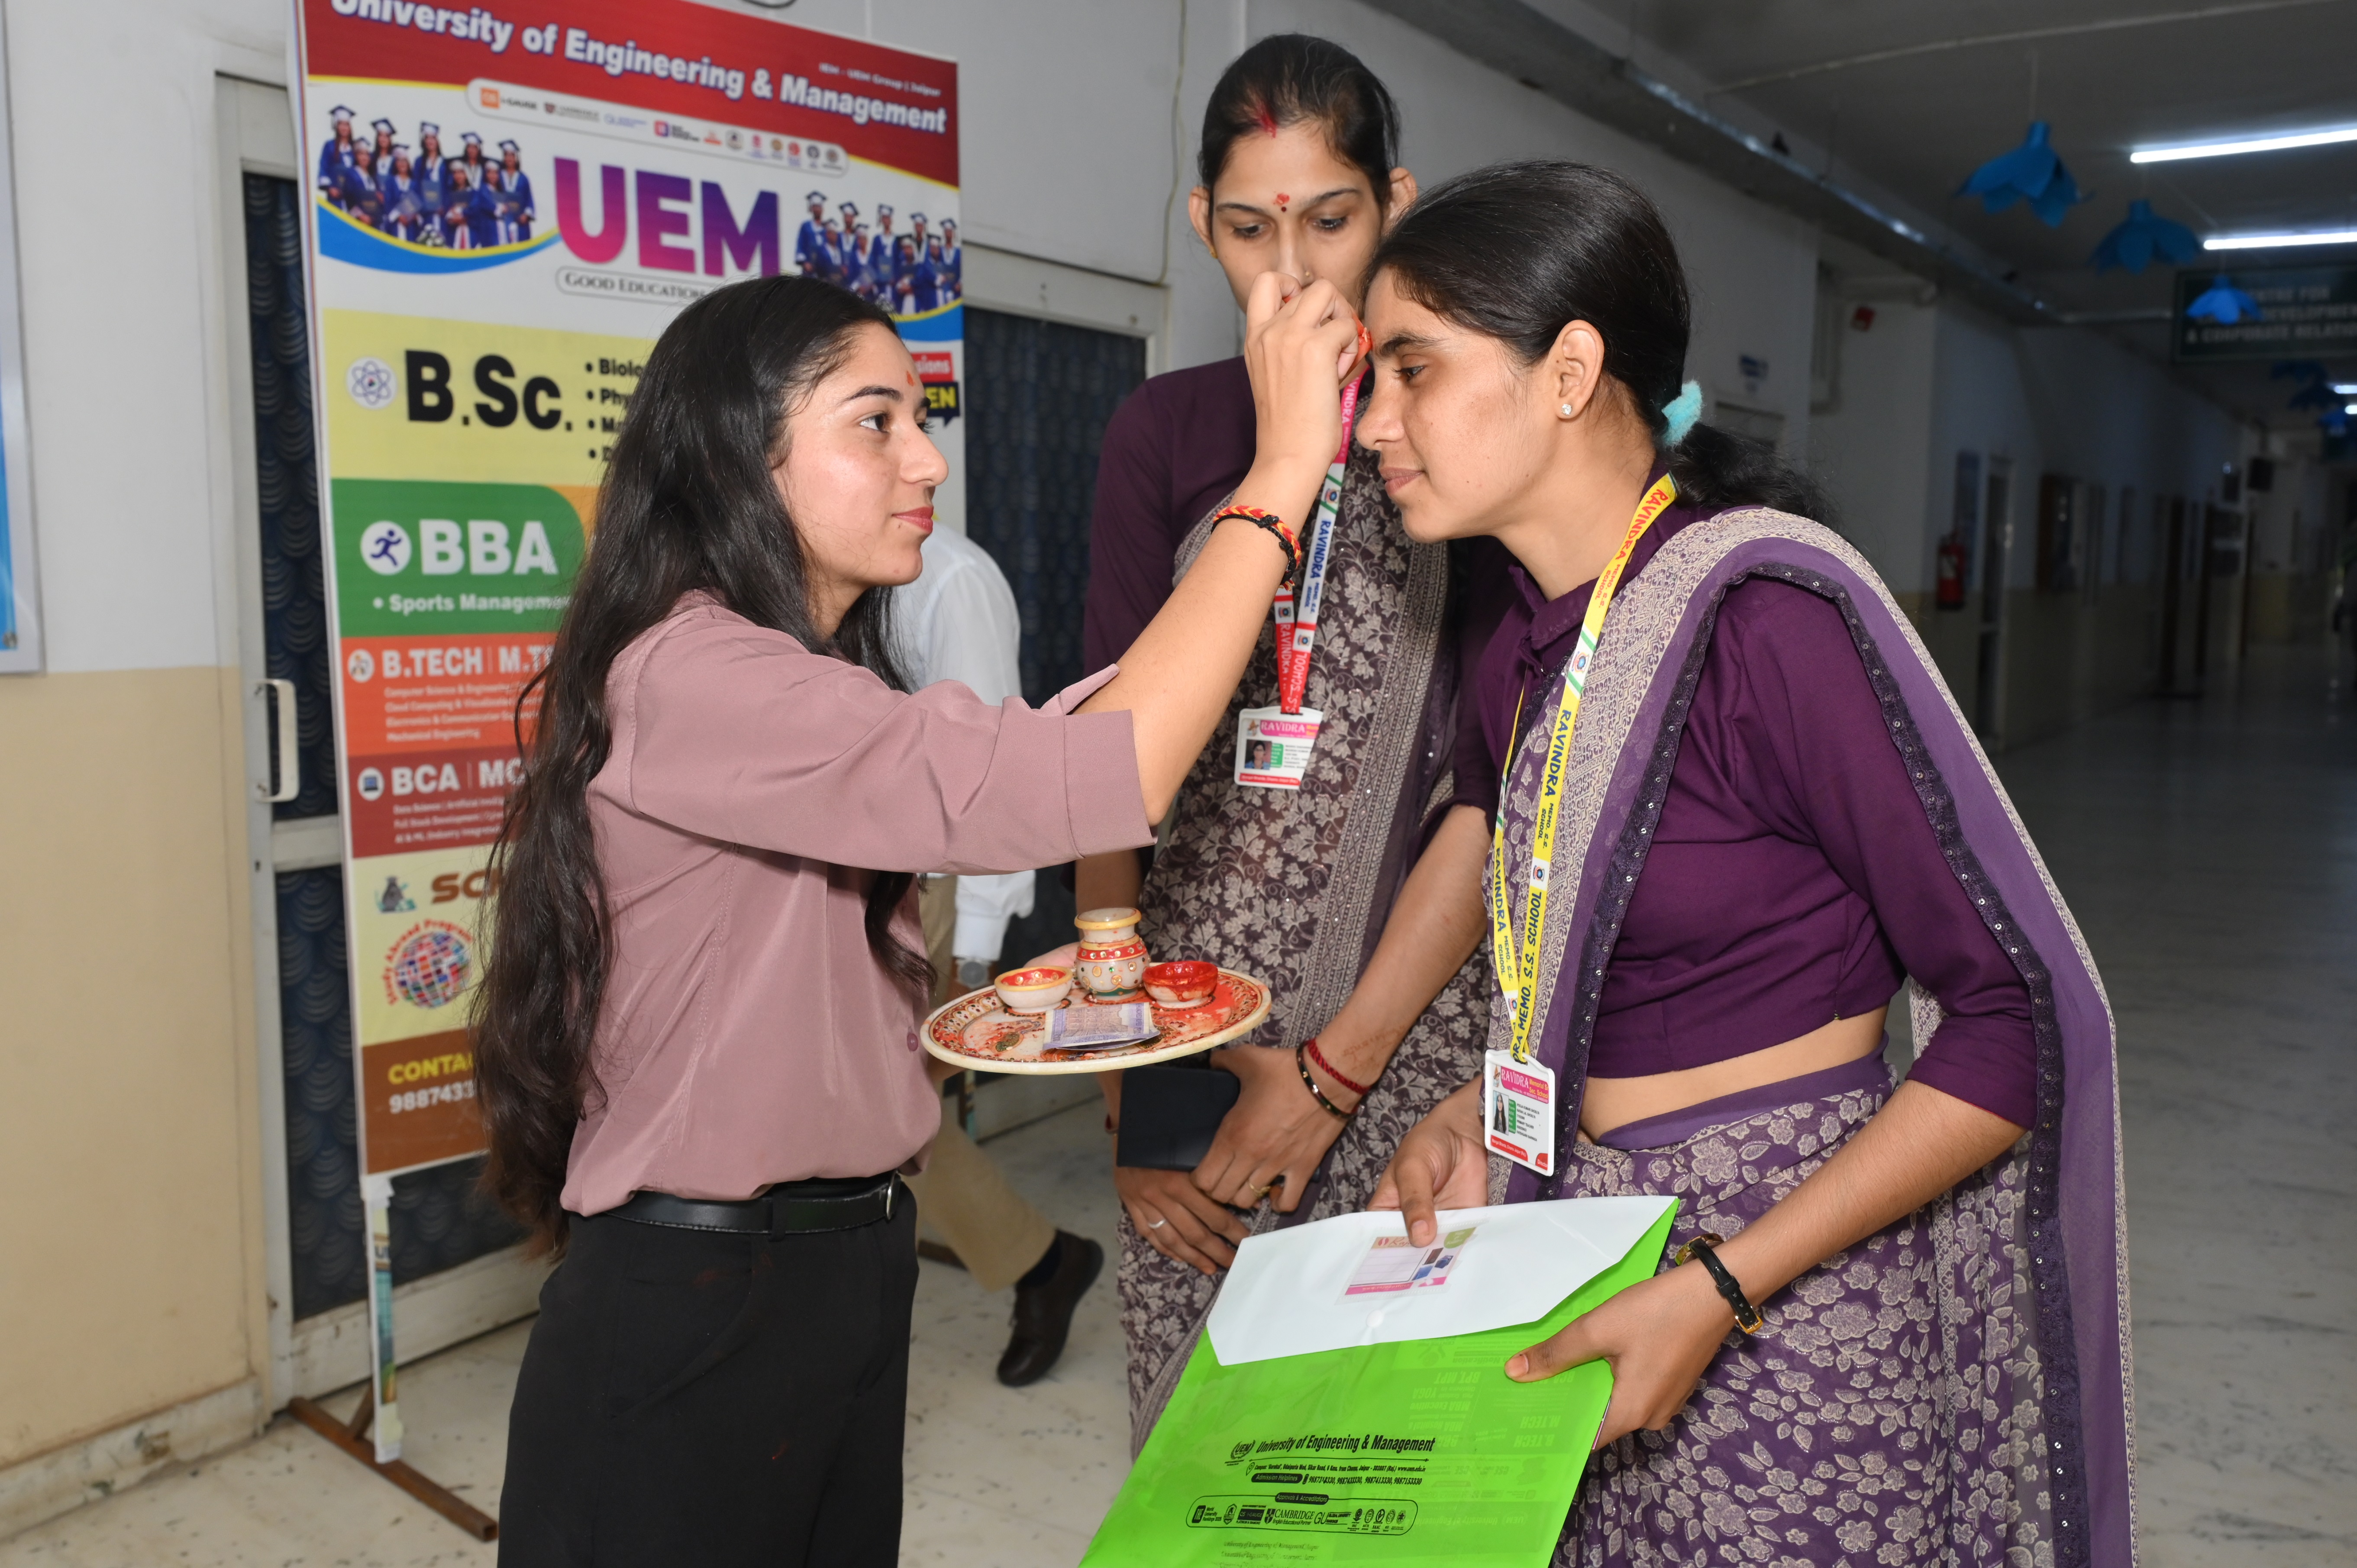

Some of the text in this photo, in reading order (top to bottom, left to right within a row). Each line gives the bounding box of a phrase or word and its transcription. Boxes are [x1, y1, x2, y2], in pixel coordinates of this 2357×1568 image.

[522, 23, 559, 55] of
[564, 27, 744, 101] Engineering
[751, 68, 773, 100] &
[780, 73, 947, 134] Management
[554, 156, 780, 278] UEM
[406, 350, 573, 432] B.Sc.
[1615, 489, 1669, 560] RAVINDRA
[419, 519, 559, 575] BBA
[1310, 520, 1332, 578] RAVINDRA
[1595, 570, 1611, 600] SCHOOL
[1598, 564, 1621, 608] MEMO. S.S.
[389, 594, 455, 616] Sports
[382, 647, 483, 678] B.TECH
[1290, 653, 1308, 692] SCHOOL
[1260, 721, 1305, 733] RAVIDRA
[1544, 709, 1572, 797] RAVINDRA
[392, 762, 460, 796] BCA
[1538, 808, 1547, 840] SCHOOL
[1545, 803, 1554, 831] MEMO.
[1495, 847, 1507, 932] RAVINDRA
[1527, 891, 1542, 946] SCHOOL
[1524, 952, 1535, 979] S.S.
[1518, 984, 1532, 1031] MEMO.
[1501, 1069, 1529, 1089] RAVIDRA
[1529, 1078, 1544, 1089] Memorial
[1537, 1089, 1549, 1099] School
[1235, 1443, 1253, 1453] UEM
[1256, 1434, 1436, 1454] University of Engineering & Management
[1364, 1476, 1393, 1485] 9887413330,
[1393, 1477, 1423, 1485] 9887153330
[1275, 1509, 1315, 1520] CAMBRIDGE
[1314, 1512, 1329, 1525] GU
